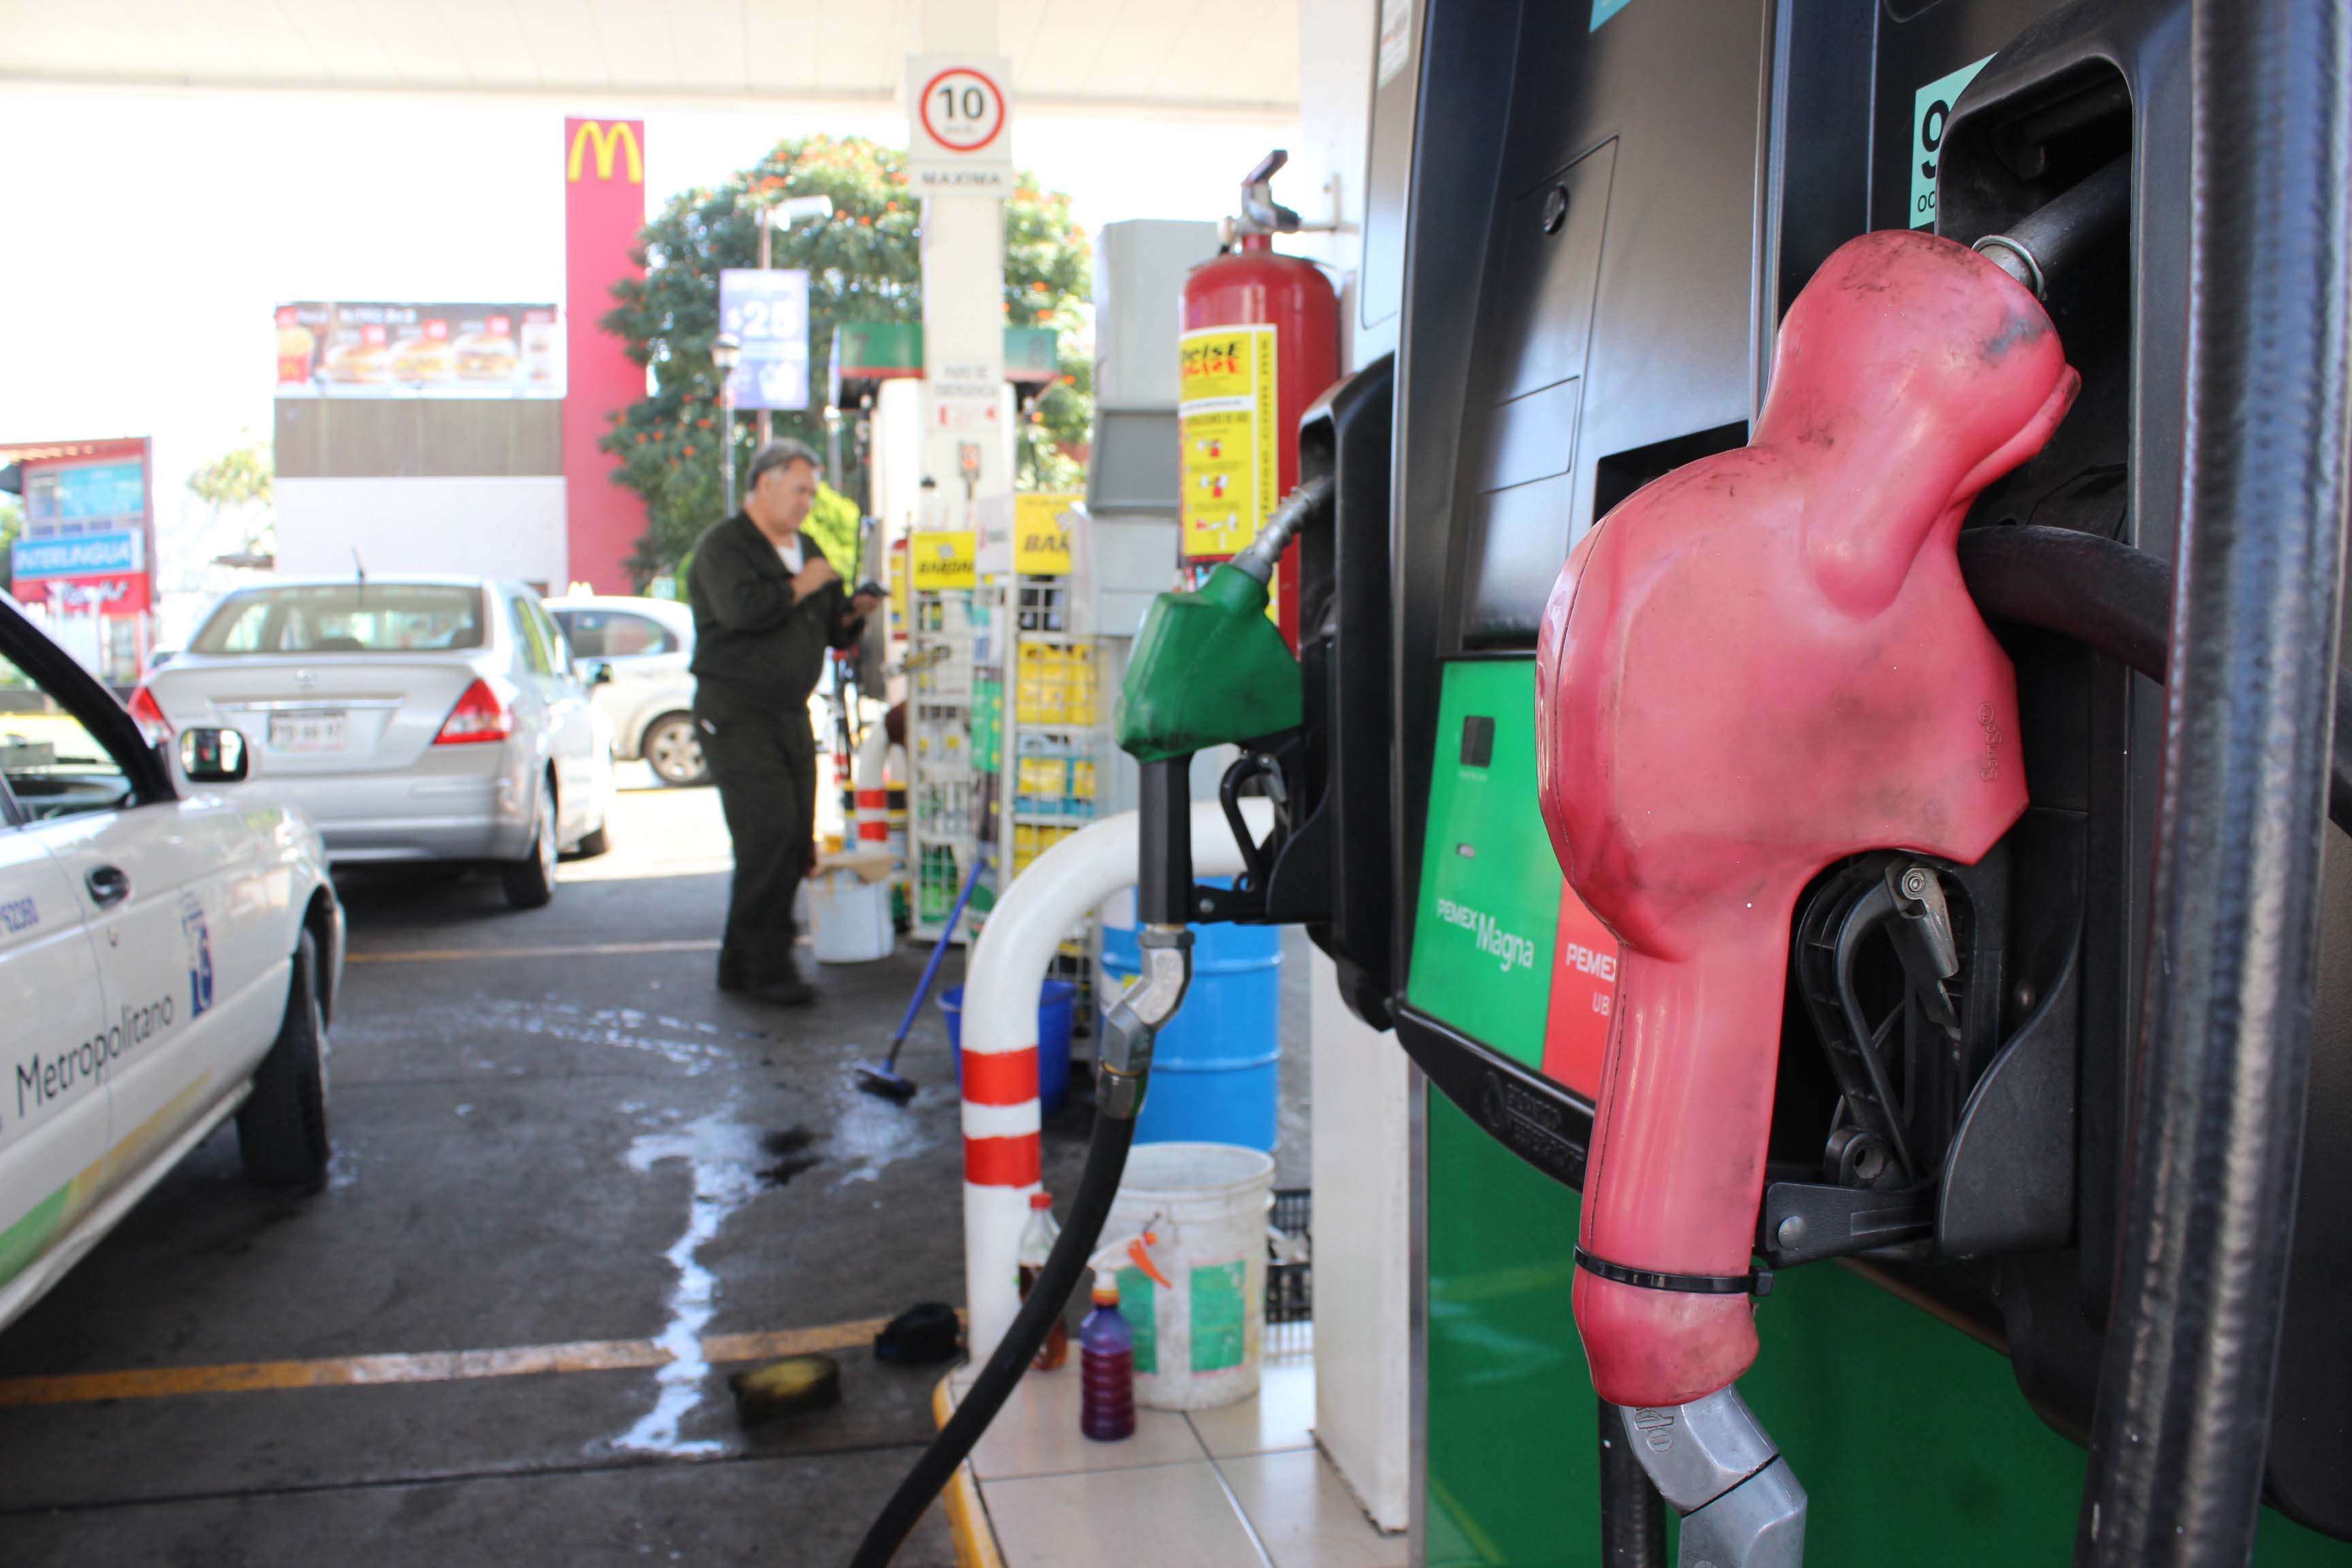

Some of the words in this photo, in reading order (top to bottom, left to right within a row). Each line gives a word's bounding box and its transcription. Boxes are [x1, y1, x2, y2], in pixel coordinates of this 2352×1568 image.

[936, 84, 984, 120] 10
[1437, 898, 1477, 931] PEMEX
[1476, 913, 1535, 972] Magna
[15, 994, 175, 1117] Metropolitano
